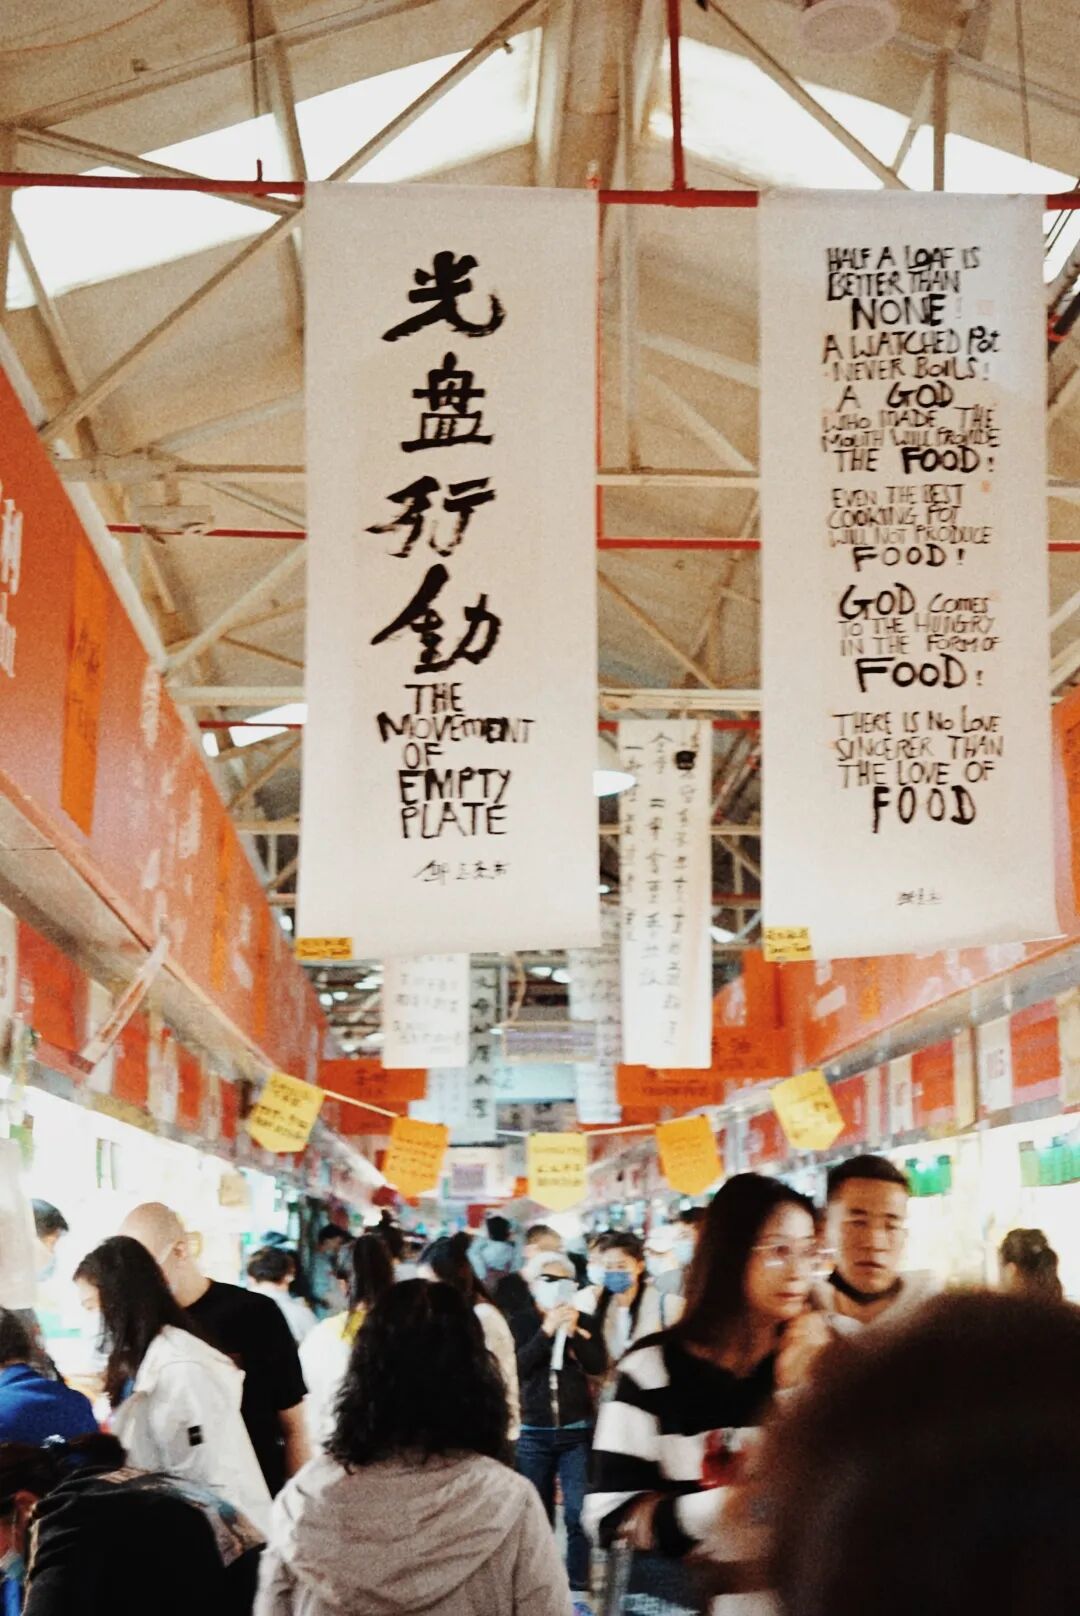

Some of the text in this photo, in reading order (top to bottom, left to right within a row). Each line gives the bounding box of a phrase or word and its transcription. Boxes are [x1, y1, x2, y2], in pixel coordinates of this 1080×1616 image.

[826, 245, 980, 273] HALF A LOAF IS
[826, 270, 960, 301] BETTER THAN
[822, 334, 844, 364] A
[850, 328, 961, 359] WATCHED
[831, 358, 905, 382] NEVER
[836, 380, 954, 413] A GOD
[879, 408, 938, 428] MADE
[953, 404, 996, 430] THE
[889, 428, 931, 447] WILL
[832, 447, 880, 472] THE
[885, 485, 918, 505] THE
[922, 482, 966, 507] BEST
[827, 506, 918, 530] COOKING
[915, 523, 992, 545] PRODUCE
[838, 582, 916, 621] GOD
[838, 612, 996, 638] TO THE HUNGRY
[840, 637, 864, 657] IN
[872, 634, 910, 655] THE
[981, 636, 1003, 653] OF
[404, 682, 463, 714] THE
[832, 711, 893, 737] THERE
[902, 711, 921, 734] IS
[403, 742, 443, 769] OF
[834, 735, 1004, 761] SINCERER THAN
[398, 766, 511, 805] EMPTY
[837, 759, 995, 789] THE LOVE OF
[400, 801, 507, 839] PLATE
[871, 784, 977, 834] FOOD
